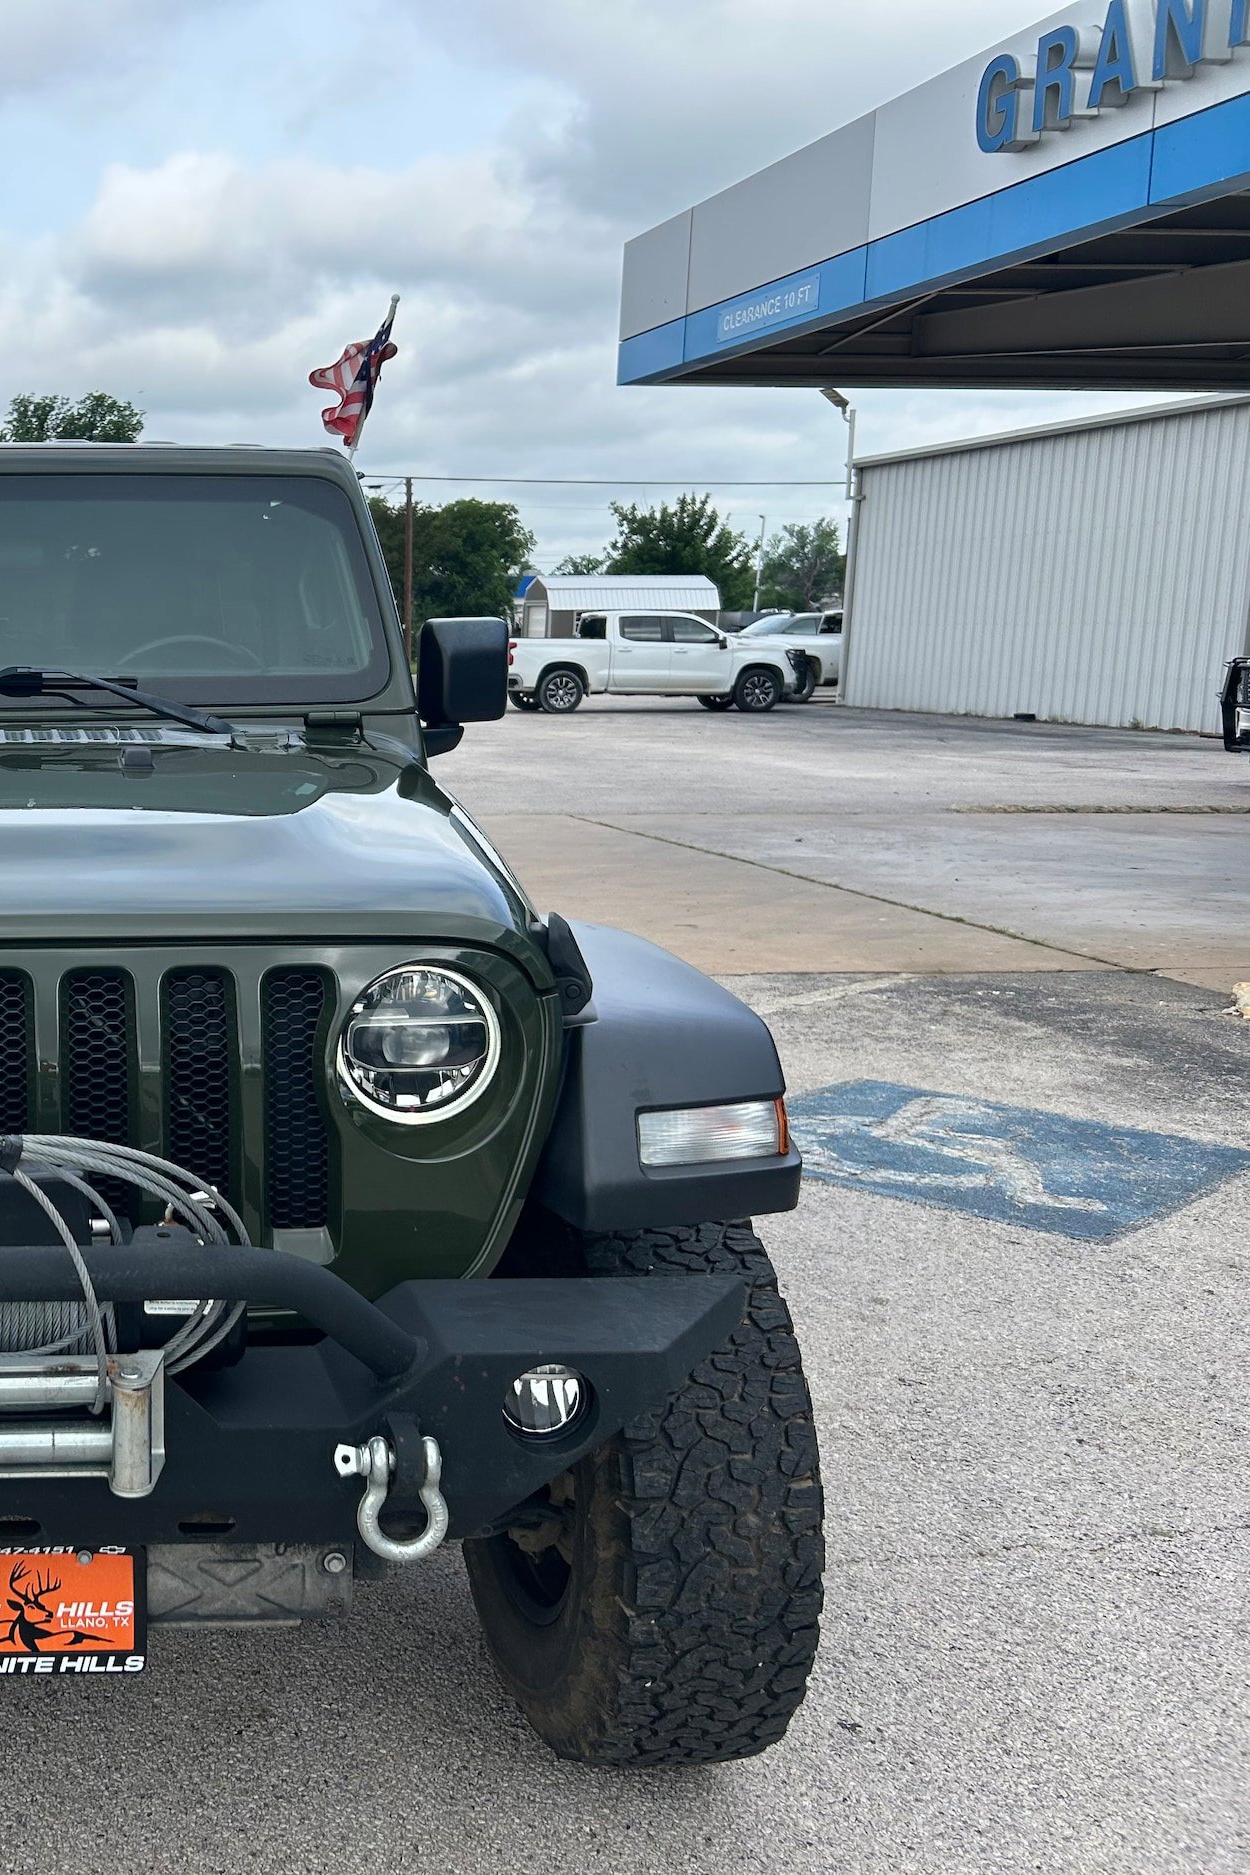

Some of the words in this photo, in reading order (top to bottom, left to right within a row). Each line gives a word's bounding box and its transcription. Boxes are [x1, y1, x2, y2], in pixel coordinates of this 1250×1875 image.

[723, 296, 781, 331] CLEARANCE
[784, 291, 795, 309] 10
[797, 285, 812, 305] FT
[56, 1601, 134, 1617] HILLS
[60, 1618, 108, 1629] LLANO,
[113, 1617, 129, 1627] TX
[59, 1655, 145, 1672] HILLS
